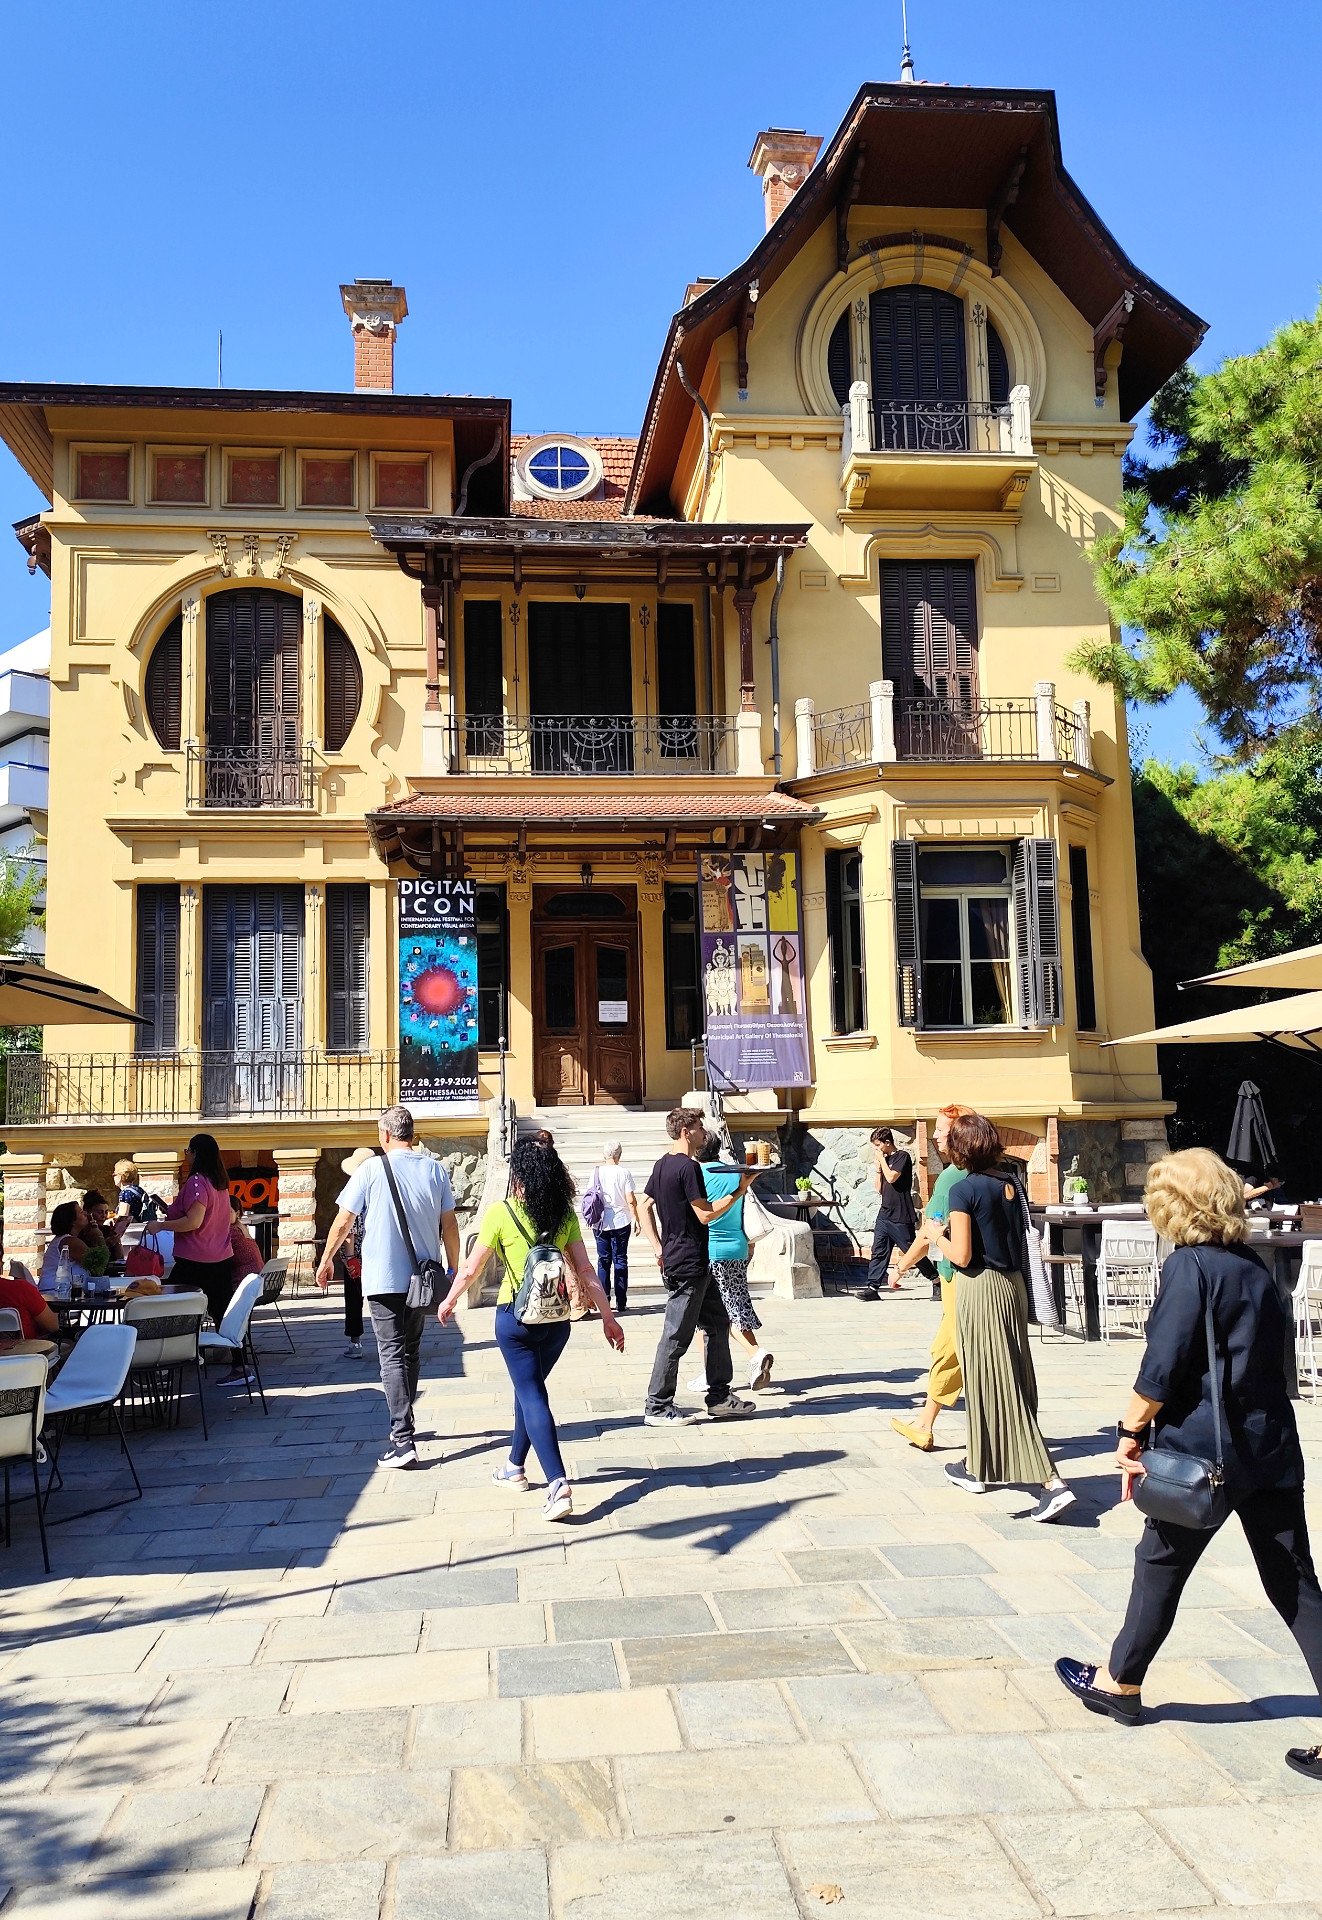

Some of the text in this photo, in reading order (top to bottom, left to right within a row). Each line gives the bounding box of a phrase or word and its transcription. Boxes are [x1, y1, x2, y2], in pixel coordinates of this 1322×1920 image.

[401, 880, 475, 895] DIGITAL
[401, 897, 474, 914] ICON
[708, 1033, 735, 1041] Municipal
[401, 1078, 416, 1087] 27,
[417, 1078, 432, 1087] 28,
[400, 1089, 416, 1097] CITY
[429, 1088, 478, 1096] THESSALONIKI
